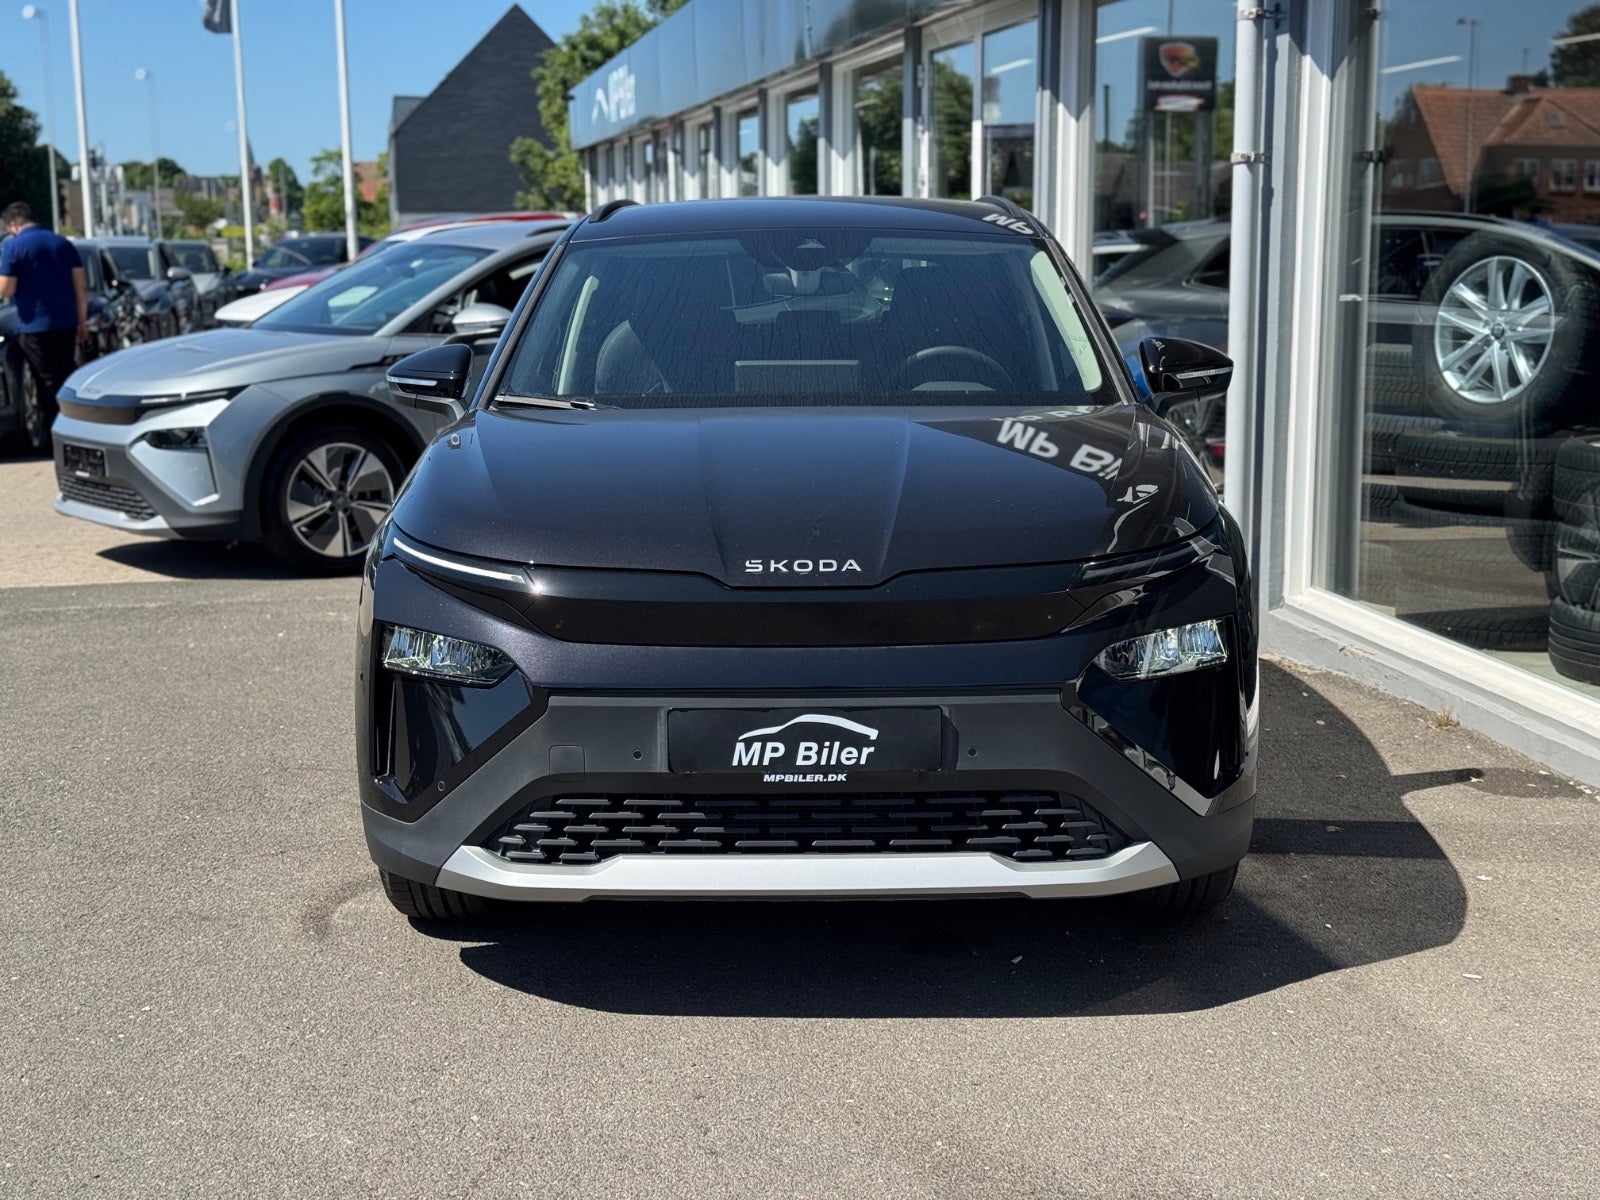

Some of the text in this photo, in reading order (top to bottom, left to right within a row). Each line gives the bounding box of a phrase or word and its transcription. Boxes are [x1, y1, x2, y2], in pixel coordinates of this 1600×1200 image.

[731, 741, 875, 767] MP Biler
[763, 773, 848, 782] MPBILER.DK
